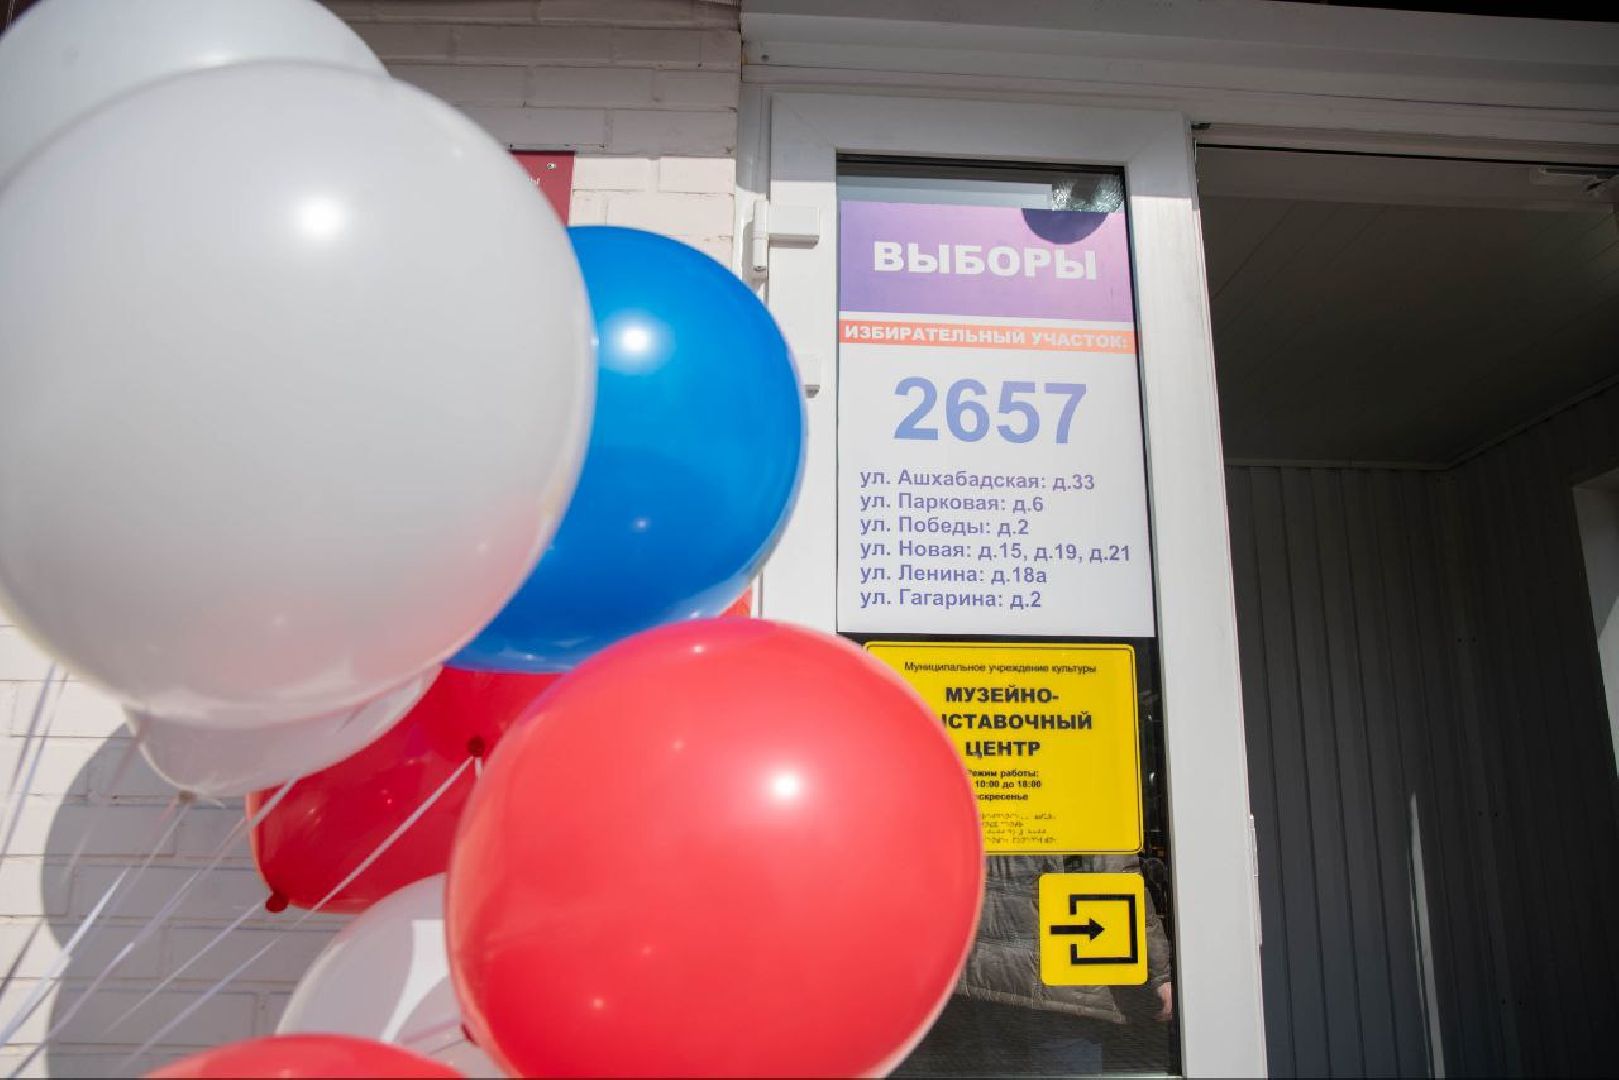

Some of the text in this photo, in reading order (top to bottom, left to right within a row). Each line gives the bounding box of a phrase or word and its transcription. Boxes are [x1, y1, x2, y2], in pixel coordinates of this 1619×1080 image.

[873, 241, 1097, 280] ВЫБОРЫ
[844, 325, 1129, 349] ИЗБИРАТЕЛЬНЫЙ УЧАСТОК:
[893, 375, 1087, 444] 2657
[860, 469, 1095, 491] ул. Ашхабадская: д.33
[860, 493, 1044, 513] ул. Парковая: д.6
[860, 516, 1029, 537] ул. Победы: д.2
[860, 540, 1131, 562] ул. Новая: д.15, д.19, д.21
[860, 564, 1048, 585] ул. Ленина: д.18а
[860, 589, 1042, 610] ул. Гагарина: д.2
[904, 661, 1097, 675] Муниципальное учреждение культуры
[946, 684, 1059, 704] МУЗЕЙНО-
[941, 710, 1092, 730] СТАВОЧНЫЙ
[965, 741, 1040, 759] ЦЕНТР
[976, 780, 1000, 788] 10:00
[1003, 781, 1015, 789] до
[1000, 769, 1039, 779] работы:
